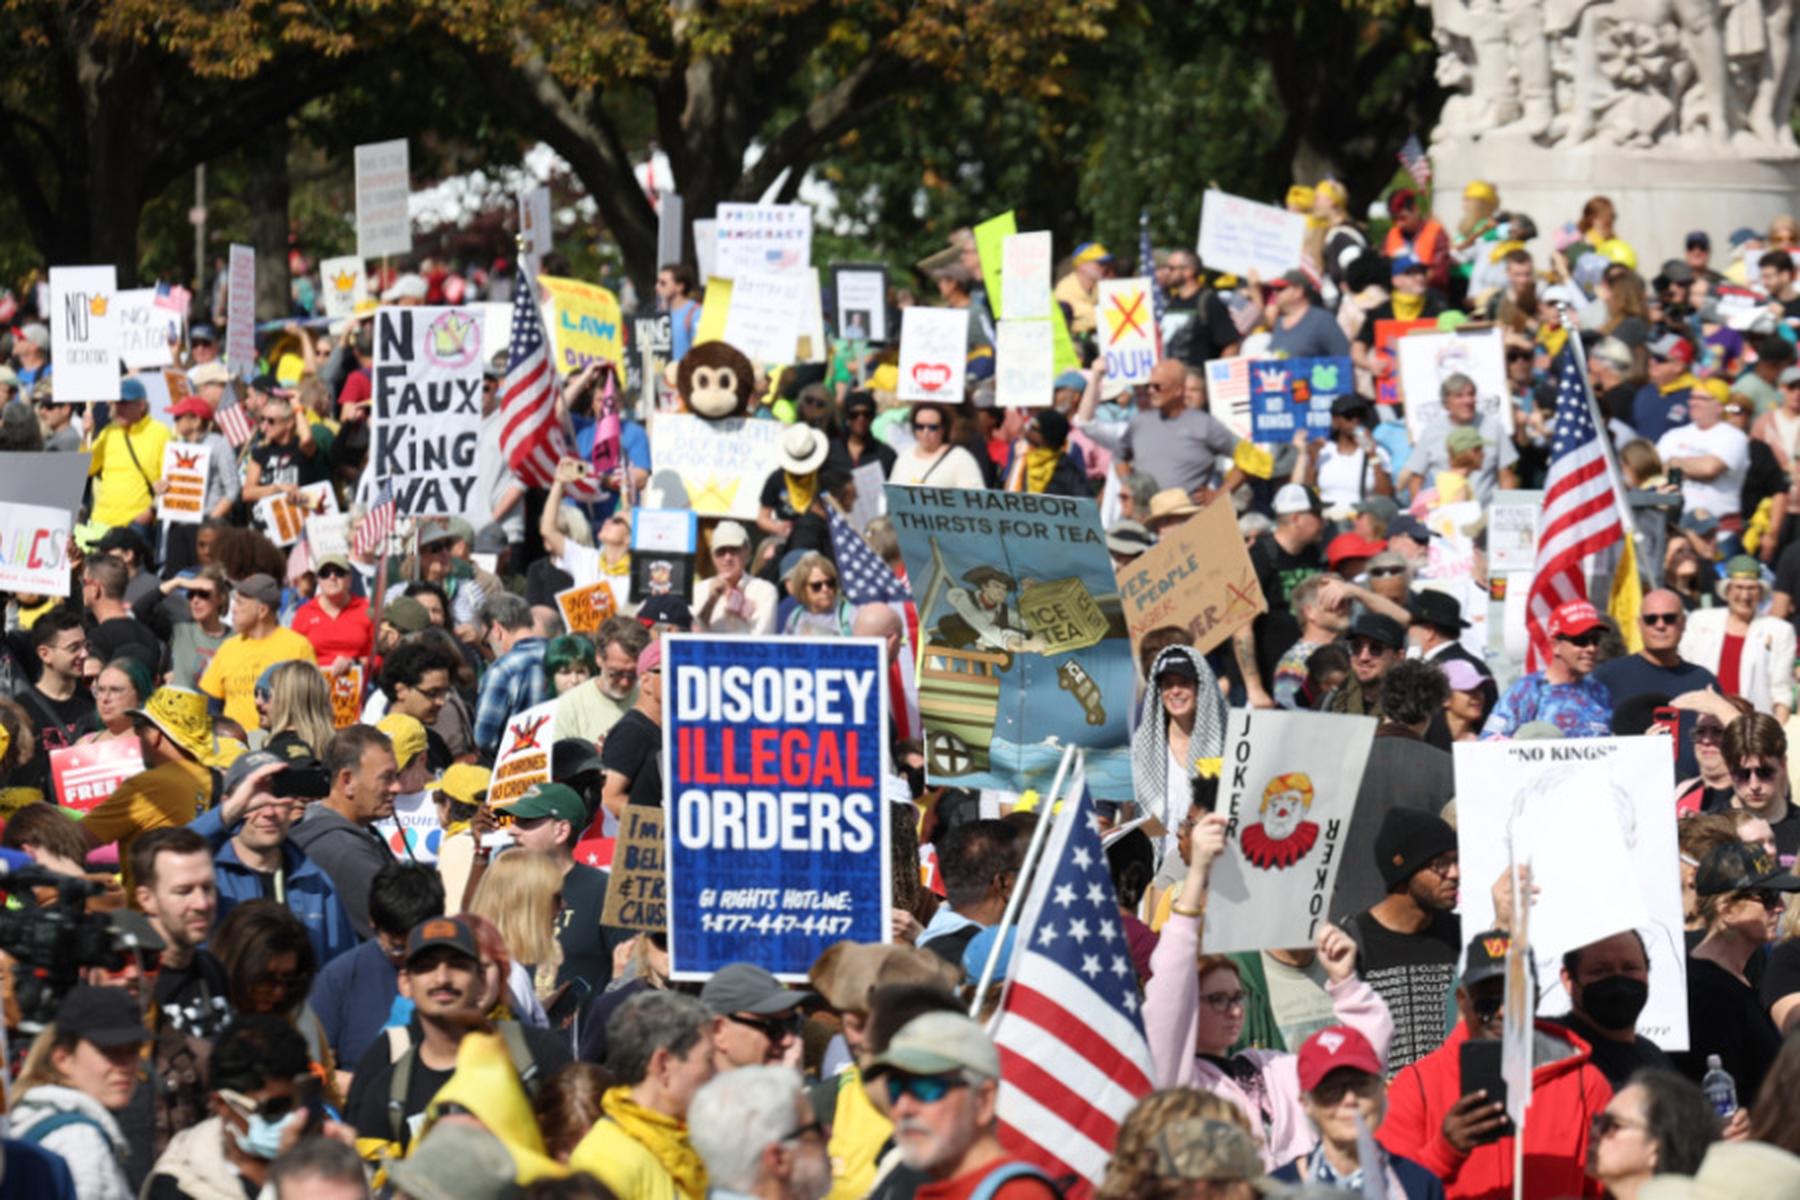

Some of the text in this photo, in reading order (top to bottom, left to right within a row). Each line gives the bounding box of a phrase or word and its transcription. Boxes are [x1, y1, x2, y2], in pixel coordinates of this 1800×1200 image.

[65, 292, 89, 342] NO
[380, 310, 414, 361] N
[561, 310, 615, 341] LAW
[1104, 350, 1151, 379] DUH
[376, 365, 480, 418] FAUX
[376, 476, 477, 515] WAY
[902, 487, 1079, 518] THE HARBOR
[897, 512, 1103, 544] THIRSTS FOR TEA
[1135, 554, 1199, 611] PEOPLE
[1029, 602, 1070, 626] ICE
[1038, 623, 1083, 644] TEA
[677, 665, 875, 725] DISOBEY
[677, 727, 875, 788] ILLEGAL
[1224, 713, 1252, 838] JOKER
[678, 789, 875, 852] ORDERS
[720, 889, 779, 910] RIGHTS
[1307, 818, 1341, 941] JOKER
